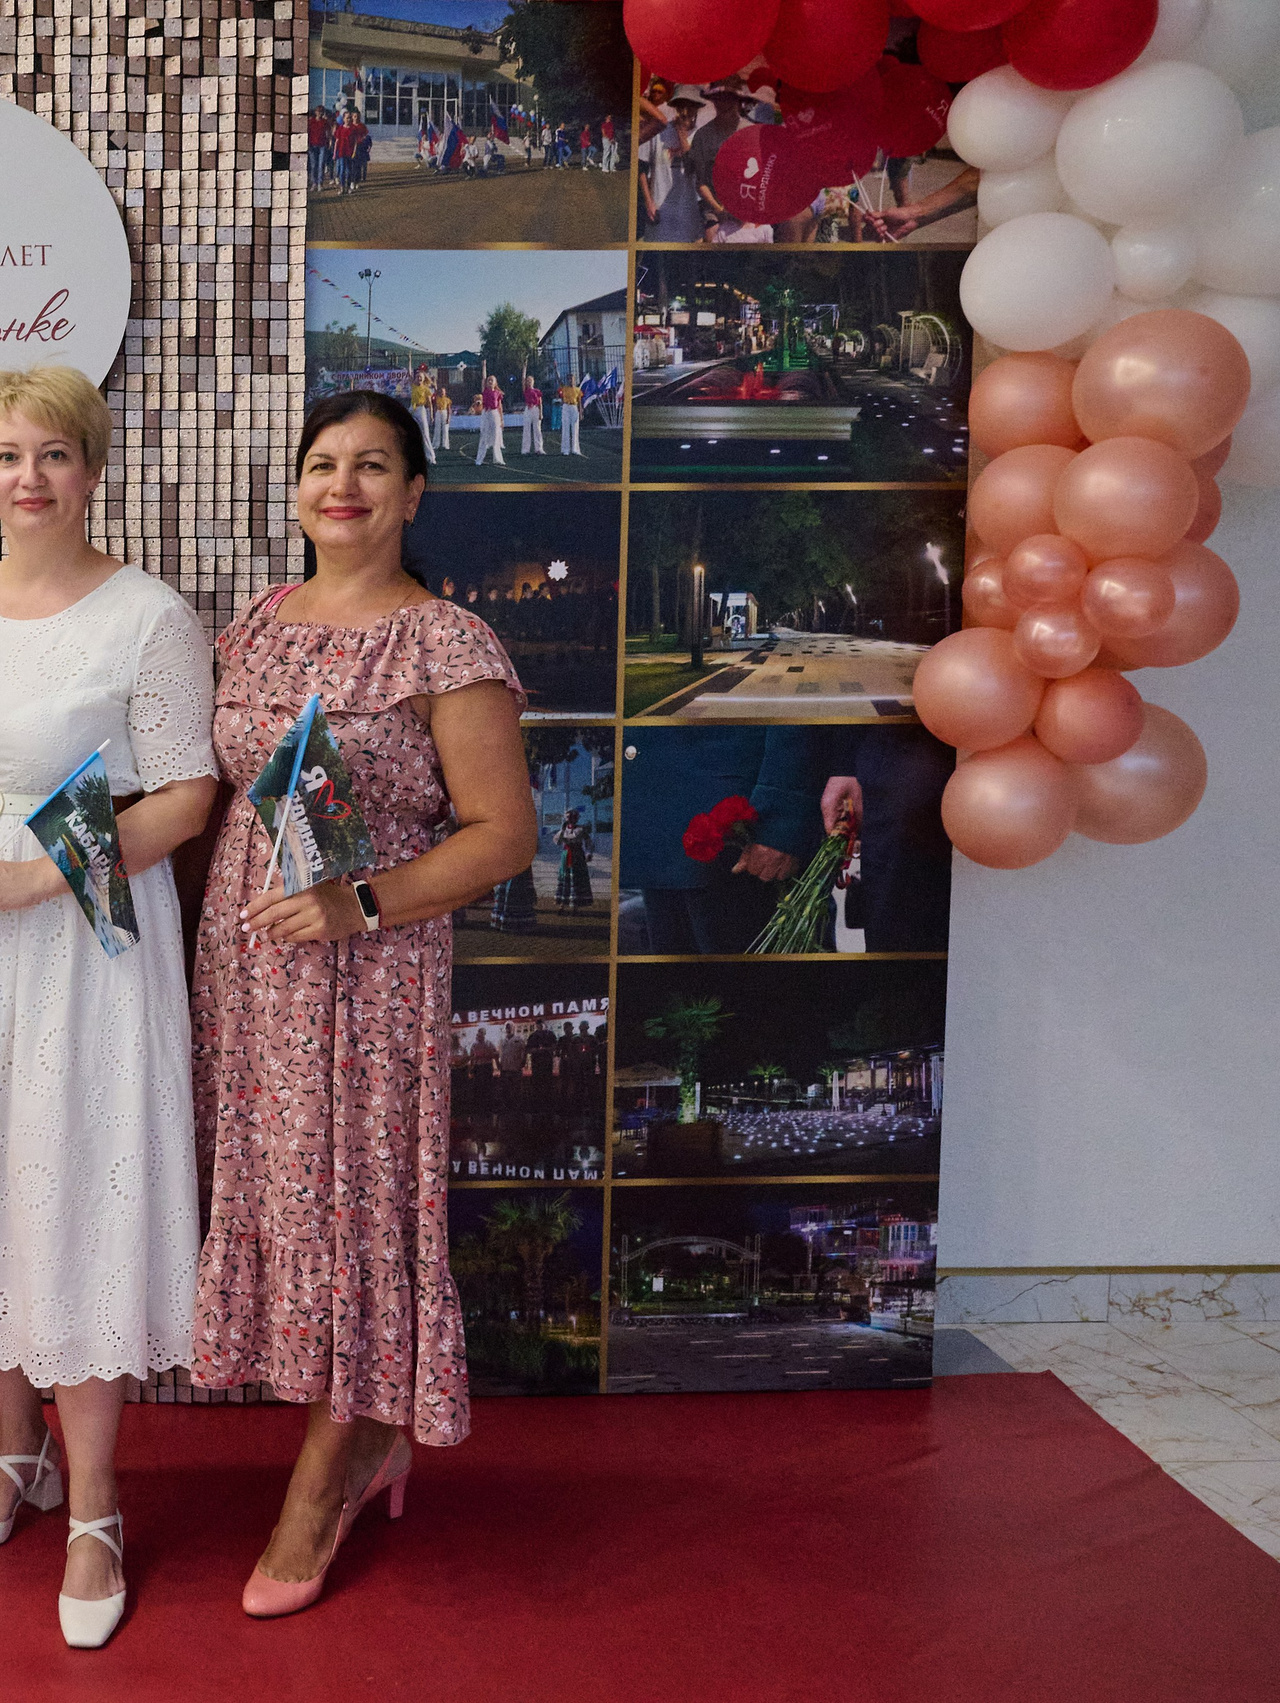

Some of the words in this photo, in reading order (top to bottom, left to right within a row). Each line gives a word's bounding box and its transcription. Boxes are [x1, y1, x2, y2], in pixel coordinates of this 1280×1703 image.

[740, 183, 757, 200] Я
[0, 245, 53, 267] ЛЕТ
[300, 766, 328, 793] Я
